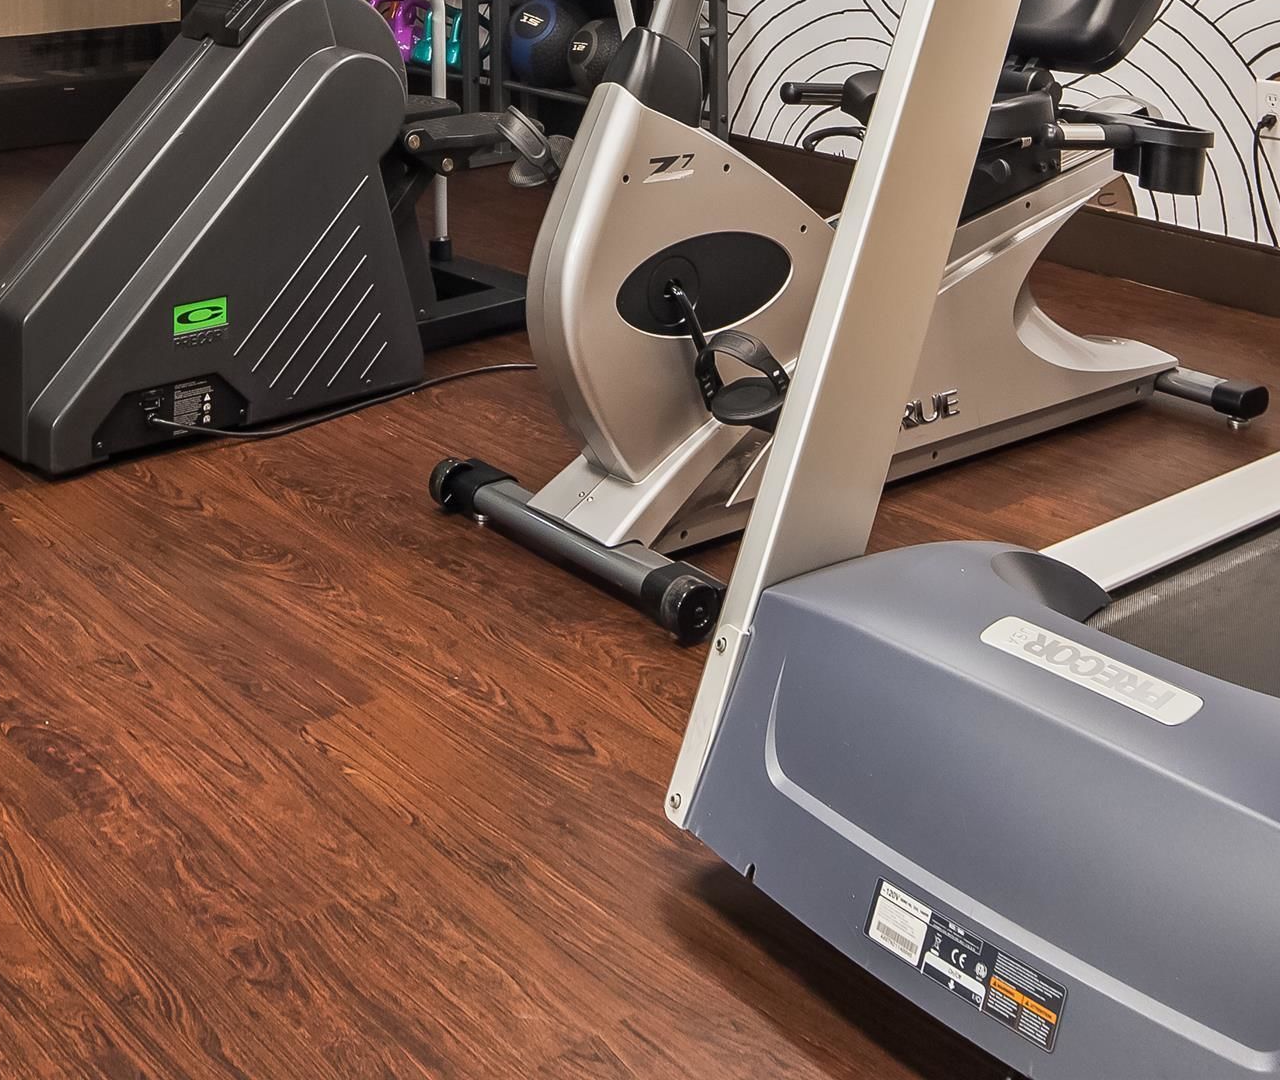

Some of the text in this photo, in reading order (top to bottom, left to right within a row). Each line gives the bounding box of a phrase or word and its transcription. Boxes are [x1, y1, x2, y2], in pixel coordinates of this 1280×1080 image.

[520, 15, 541, 27] 15
[572, 44, 586, 52] 12
[899, 388, 961, 432] RUE
[1023, 633, 1176, 710] PRECOR
